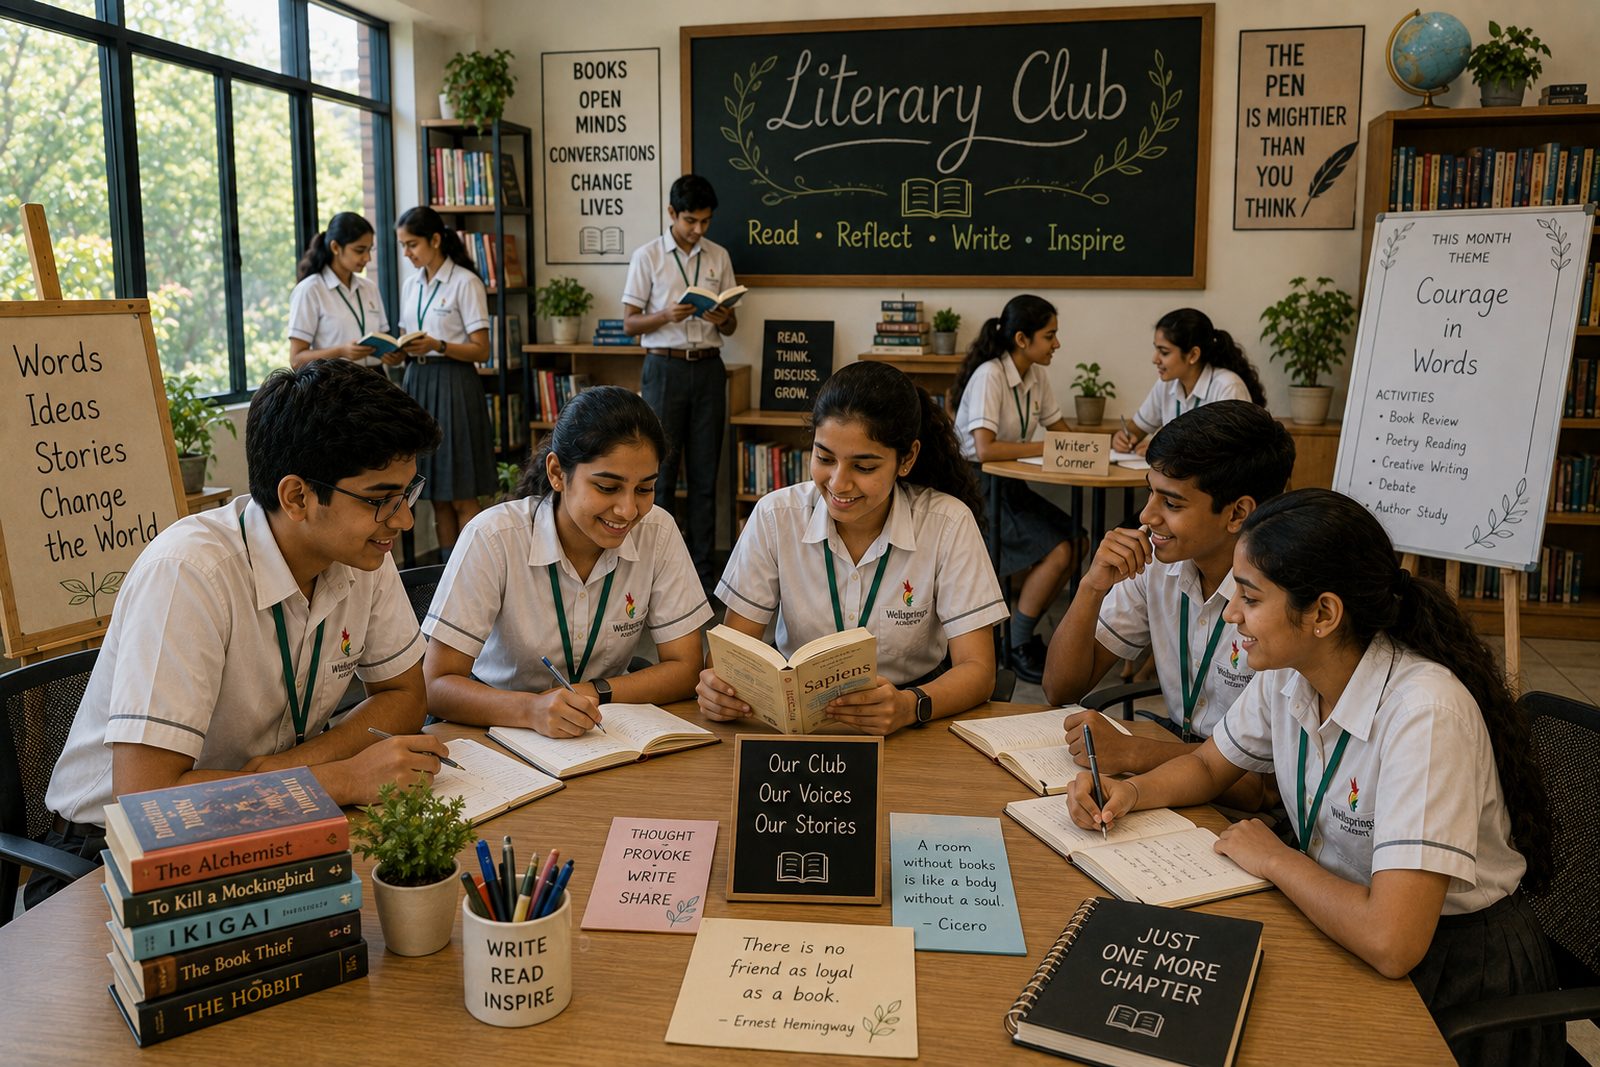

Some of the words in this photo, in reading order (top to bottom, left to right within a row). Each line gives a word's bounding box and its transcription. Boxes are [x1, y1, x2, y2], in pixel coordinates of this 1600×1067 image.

[1266, 44, 1304, 67] THE
[573, 61, 628, 80] BOOKS
[1266, 74, 1304, 97] PEN
[579, 91, 621, 108] OPEN
[766, 49, 982, 174] Literary
[1012, 48, 1127, 123] Club
[1246, 108, 1260, 127] IS
[1267, 106, 1347, 127] MIGHTIER
[576, 115, 626, 133] MINDS
[550, 145, 655, 162] CONVERSATIONS
[1261, 137, 1305, 156] THAN
[571, 173, 632, 191] CHANGE
[1257, 166, 1293, 187] YOU
[581, 198, 623, 216] LIVES
[1245, 198, 1296, 218] THINK
[748, 219, 799, 245] Read
[837, 220, 912, 249] Reflect
[952, 224, 1011, 250] Write
[1048, 224, 1125, 260] Inspire
[1432, 234, 1459, 245] THIS
[1466, 233, 1511, 244] MONTH
[1449, 252, 1489, 263] THEME
[1417, 277, 1508, 317] Courage
[778, 332, 808, 344] READ.
[1444, 318, 1462, 338] in
[13, 341, 102, 378] Words
[777, 351, 811, 363] THINK.
[1414, 349, 1478, 375] Words
[774, 368, 819, 381] DISCUSS.
[775, 387, 809, 399] GROW.
[1376, 390, 1434, 403] ACTIVITIES
[26, 393, 100, 426] Ideas
[1389, 411, 1415, 424] Book
[1422, 414, 1459, 427] Review
[1055, 439, 1099, 453] Writer's
[1386, 433, 1419, 451] Poetry
[1425, 438, 1466, 456] Reading
[36, 440, 126, 473] Stories
[1056, 456, 1094, 469] Corner
[1382, 456, 1424, 471] Creative
[1431, 462, 1469, 480] Writing
[1379, 479, 1416, 494] Debate
[40, 487, 126, 522] Change
[1375, 500, 1411, 516] Author
[1417, 505, 1448, 525] Study
[45, 530, 87, 562] the
[94, 512, 158, 552] World
[804, 663, 871, 694] Sapiens
[769, 754, 800, 773] Our
[808, 754, 846, 774] Club
[759, 783, 791, 802] Our
[800, 783, 852, 804] Voices
[755, 813, 787, 834] Our
[796, 815, 856, 835] Stories
[632, 829, 695, 841] THOUGHT
[623, 848, 692, 861] PROVOKE
[918, 840, 928, 851] A
[935, 842, 972, 852] room
[155, 860, 191, 881] The
[198, 841, 292, 872] Alchemist
[904, 858, 952, 870] without
[959, 858, 996, 871] books
[628, 870, 676, 884] WRITE
[905, 875, 915, 885] is
[922, 874, 944, 887] like
[966, 875, 997, 892] body
[148, 900, 169, 916] To
[175, 892, 202, 910] Kill
[208, 892, 216, 903] a
[222, 868, 314, 900] Mockingbird
[619, 892, 672, 906] SHARE
[904, 893, 953, 905] without
[974, 895, 1004, 907] soul.
[169, 908, 270, 947] IKIGAI
[938, 917, 987, 932] Cicero
[487, 936, 547, 958] WRITE
[743, 937, 790, 953] There
[800, 941, 814, 954] is
[824, 944, 845, 955] no
[1138, 928, 1200, 951] JUST
[180, 965, 210, 981] The
[214, 954, 250, 971] Book
[255, 938, 293, 960] Thief
[1102, 944, 1148, 968] ONE
[1154, 954, 1221, 982] MORE
[491, 966, 543, 984] READ
[729, 959, 781, 978] friend
[789, 966, 807, 977] as
[816, 964, 853, 984] loyal
[743, 989, 762, 1000] as
[772, 990, 782, 1000] a
[793, 987, 839, 1003] book.
[1100, 968, 1202, 1005] CHAPTER
[184, 997, 224, 1022] THE
[232, 973, 302, 1008] HOBBIT
[484, 986, 555, 1011] INSPIRE
[734, 1015, 776, 1029] Ernest
[783, 1018, 854, 1037] Hemingway
